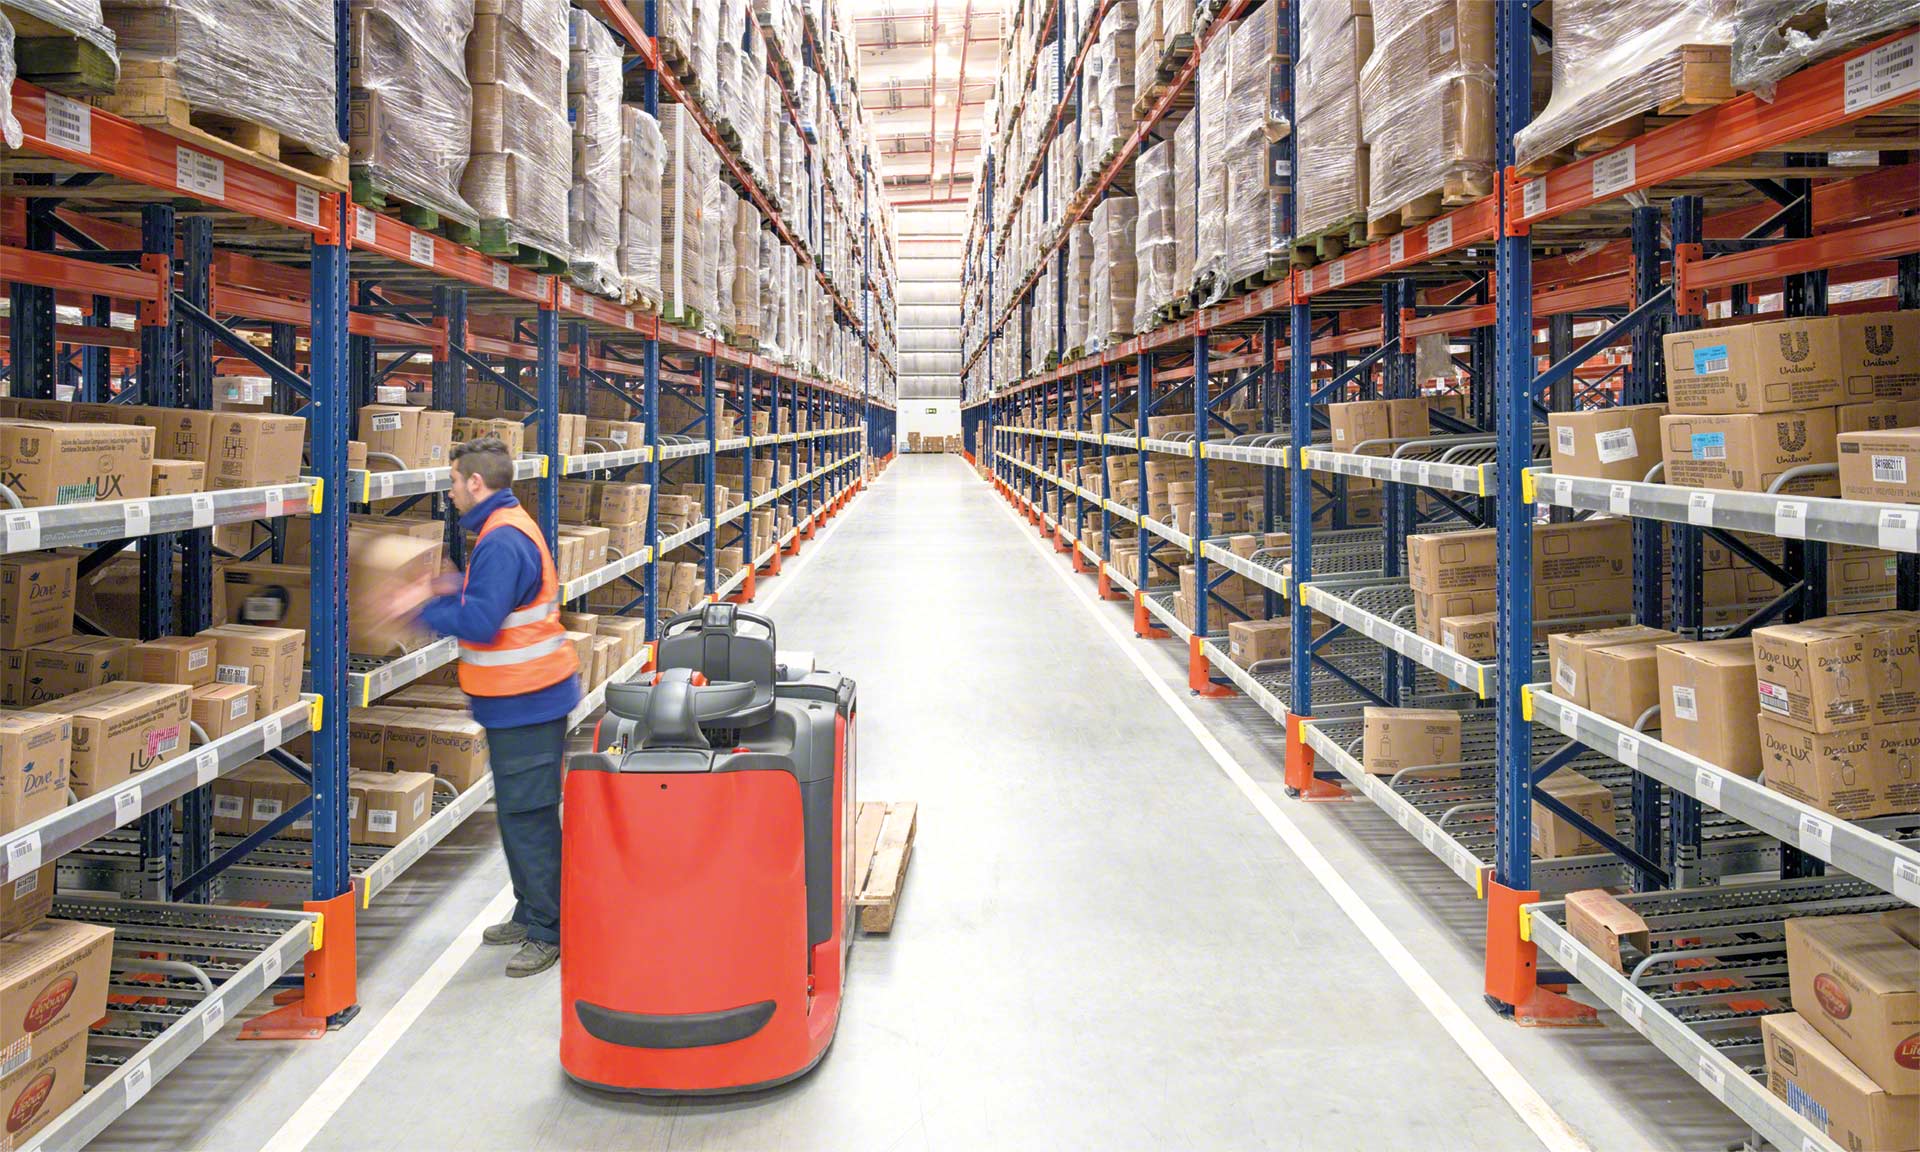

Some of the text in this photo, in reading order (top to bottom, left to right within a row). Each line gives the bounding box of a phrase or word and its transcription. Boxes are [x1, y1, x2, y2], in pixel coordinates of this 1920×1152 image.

[1863, 356, 1899, 367] Unilever
[1780, 363, 1815, 375] Unilever
[29, 583, 56, 600] Dove
[1463, 632, 1489, 640] Rexona
[31, 687, 64, 700] Dove
[387, 730, 416, 742] Rexona
[432, 735, 460, 747] Rexona
[1766, 733, 1788, 752] Dove
[24, 770, 52, 793] Dove
